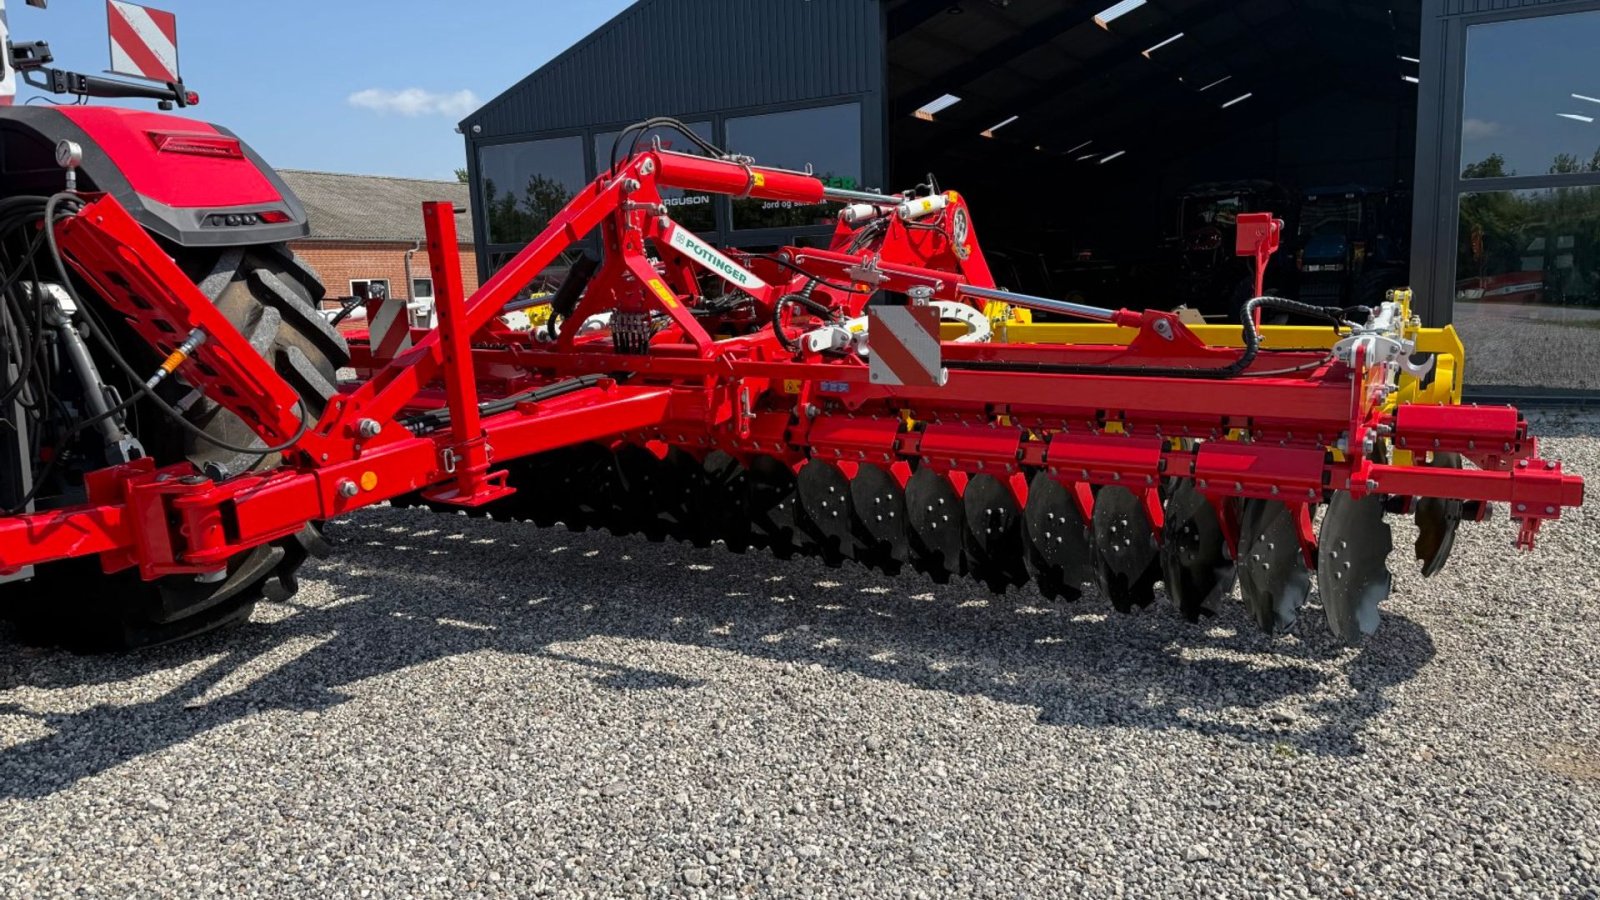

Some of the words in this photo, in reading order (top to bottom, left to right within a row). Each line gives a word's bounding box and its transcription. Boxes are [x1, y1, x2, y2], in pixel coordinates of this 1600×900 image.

[664, 195, 710, 206] RGUSON
[761, 200, 780, 209] Jord
[781, 201, 792, 209] og
